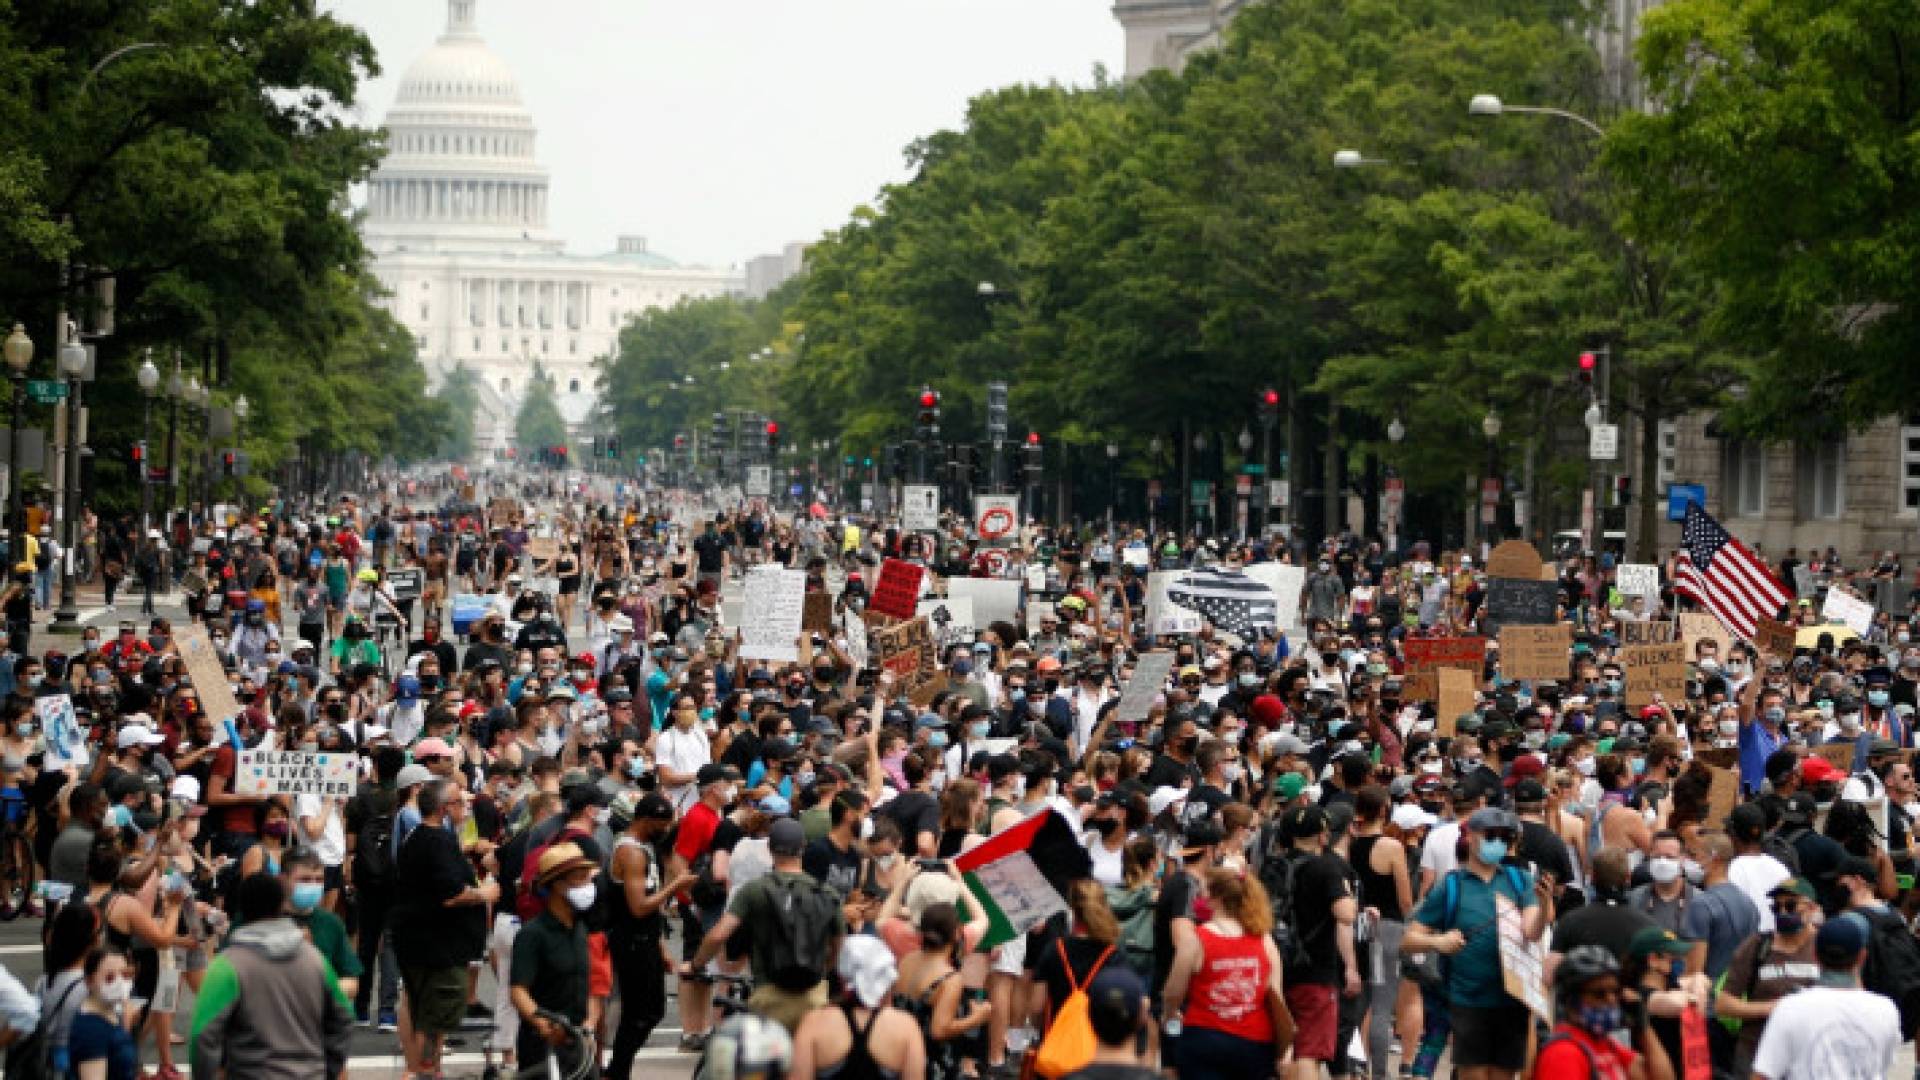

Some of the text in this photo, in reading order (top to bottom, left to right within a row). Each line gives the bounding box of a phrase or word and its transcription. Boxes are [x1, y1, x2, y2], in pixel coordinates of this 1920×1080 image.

[1627, 647, 1683, 667] SILENCE
[255, 752, 314, 765] BLACK
[267, 766, 324, 779] LIVES
[278, 780, 349, 795] MATTER
